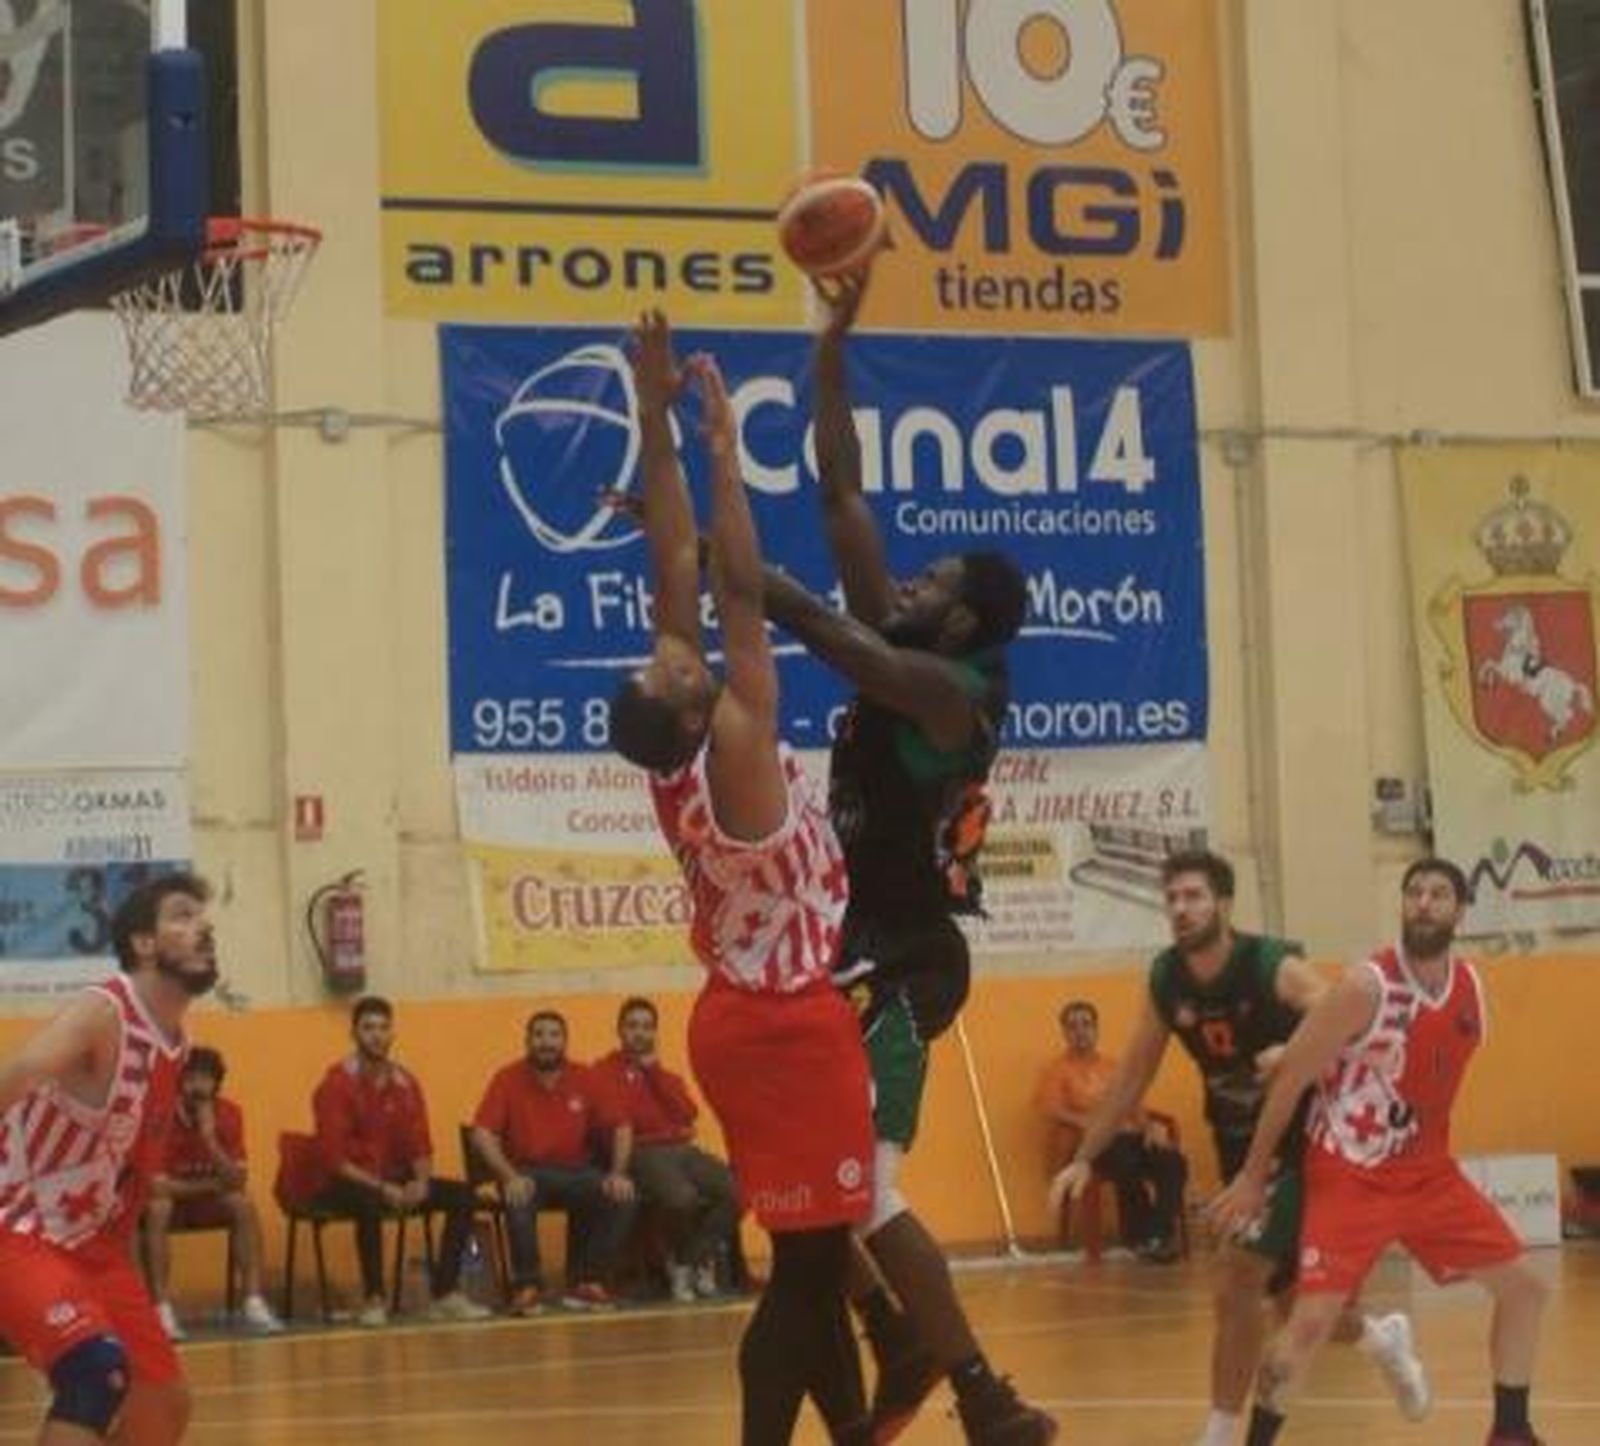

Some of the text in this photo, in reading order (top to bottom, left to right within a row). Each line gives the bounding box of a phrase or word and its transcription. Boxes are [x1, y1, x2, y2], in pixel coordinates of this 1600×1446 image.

[405, 243, 775, 293] arrones
[936, 263, 1122, 313] tiendas
[896, 501, 1156, 536] Comunicaciones
[495, 572, 565, 630] La
[1024, 568, 1164, 626] Morón
[472, 698, 566, 747] 955
[586, 766, 645, 790] Alon
[512, 875, 692, 930] Cruzca
